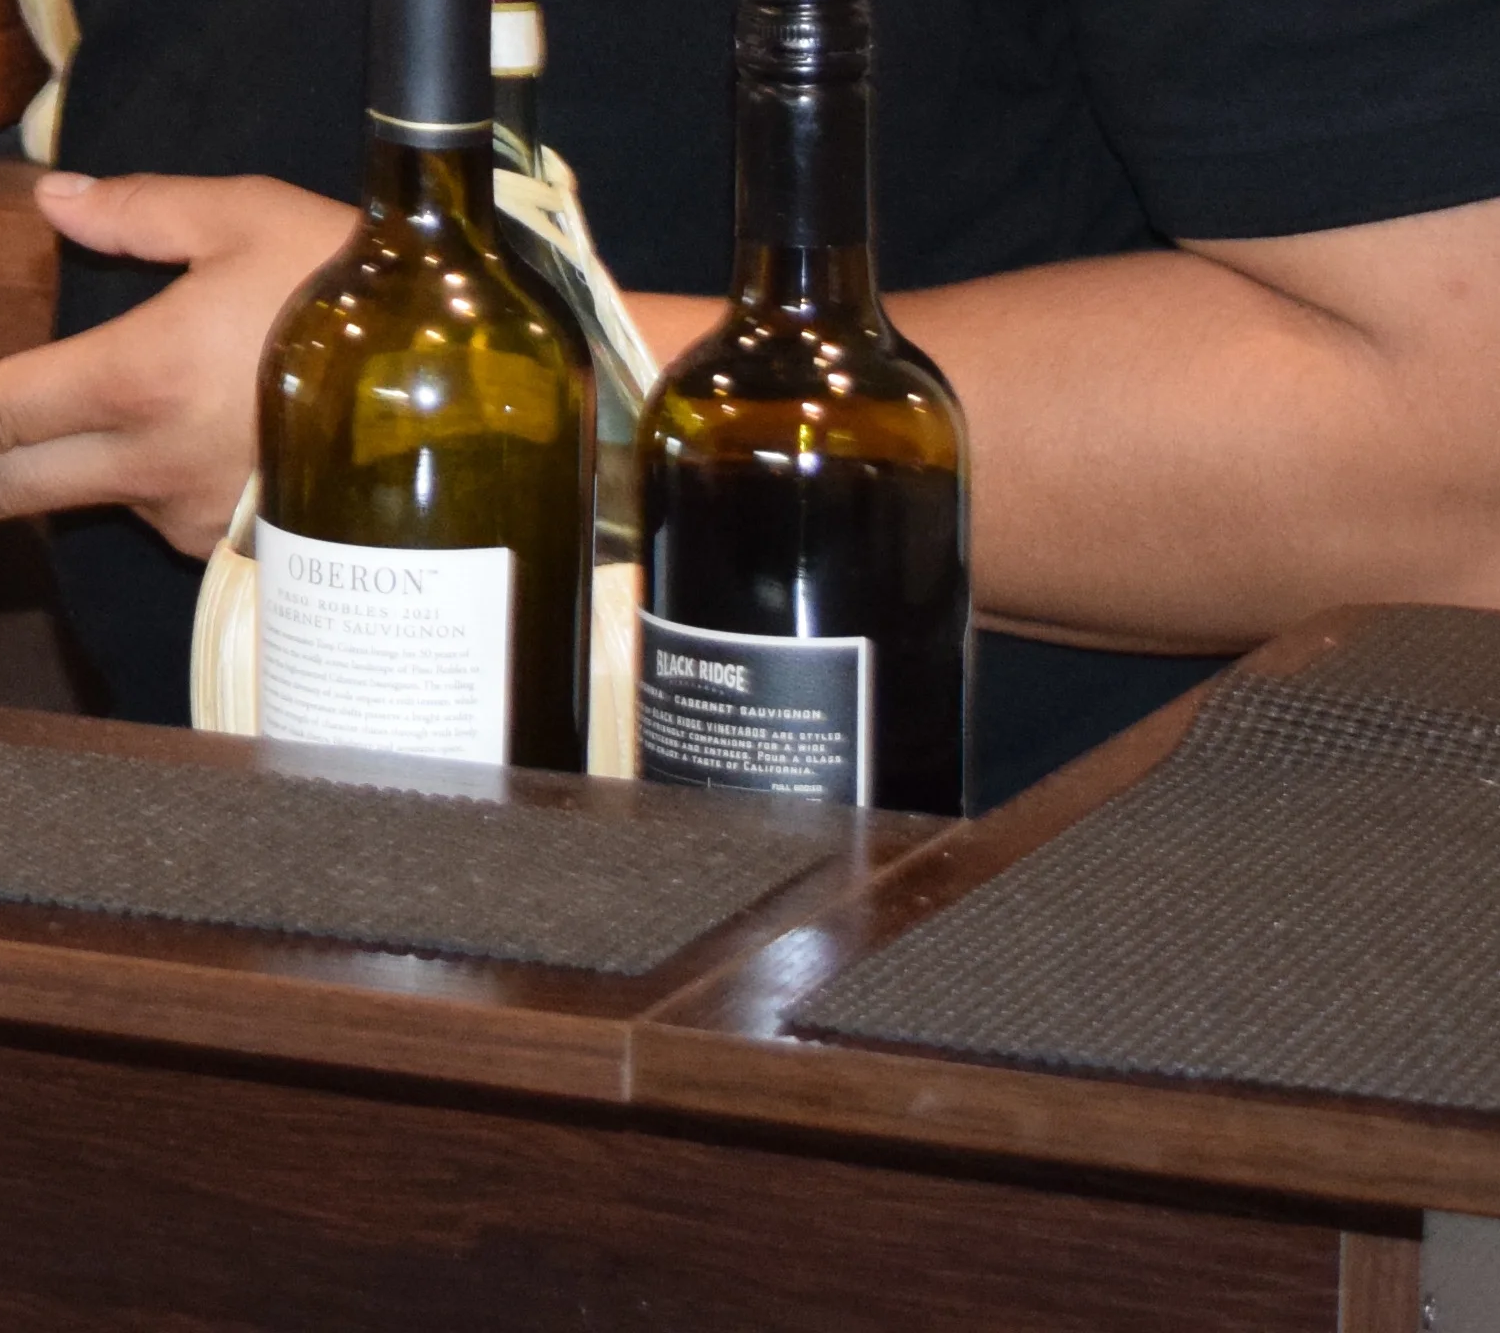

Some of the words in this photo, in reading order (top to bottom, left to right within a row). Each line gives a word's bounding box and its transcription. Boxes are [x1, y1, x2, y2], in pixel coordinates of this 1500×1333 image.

[288, 553, 424, 595] OBERON
[278, 587, 309, 606] PASO
[318, 599, 389, 618] ROBLES
[266, 598, 335, 630] CABERNET
[343, 619, 466, 638] SAUVIGNON
[656, 649, 694, 677] BLACK
[699, 660, 748, 693] RIDGE
[674, 695, 733, 714] CABERNET
[739, 706, 822, 720] SAUVIGNON
[689, 731, 753, 750] COMPANIONS
[757, 741, 778, 751] FOR
[784, 743, 792, 752] A
[797, 743, 826, 752] WIDE
[706, 721, 767, 738] VINEYARDS
[772, 731, 794, 741] ARE
[799, 731, 842, 742] STYLED
[692, 754, 721, 768] TASTE
[726, 759, 738, 770] OF
[793, 755, 800, 763] A
[805, 755, 842, 764] GLASS
